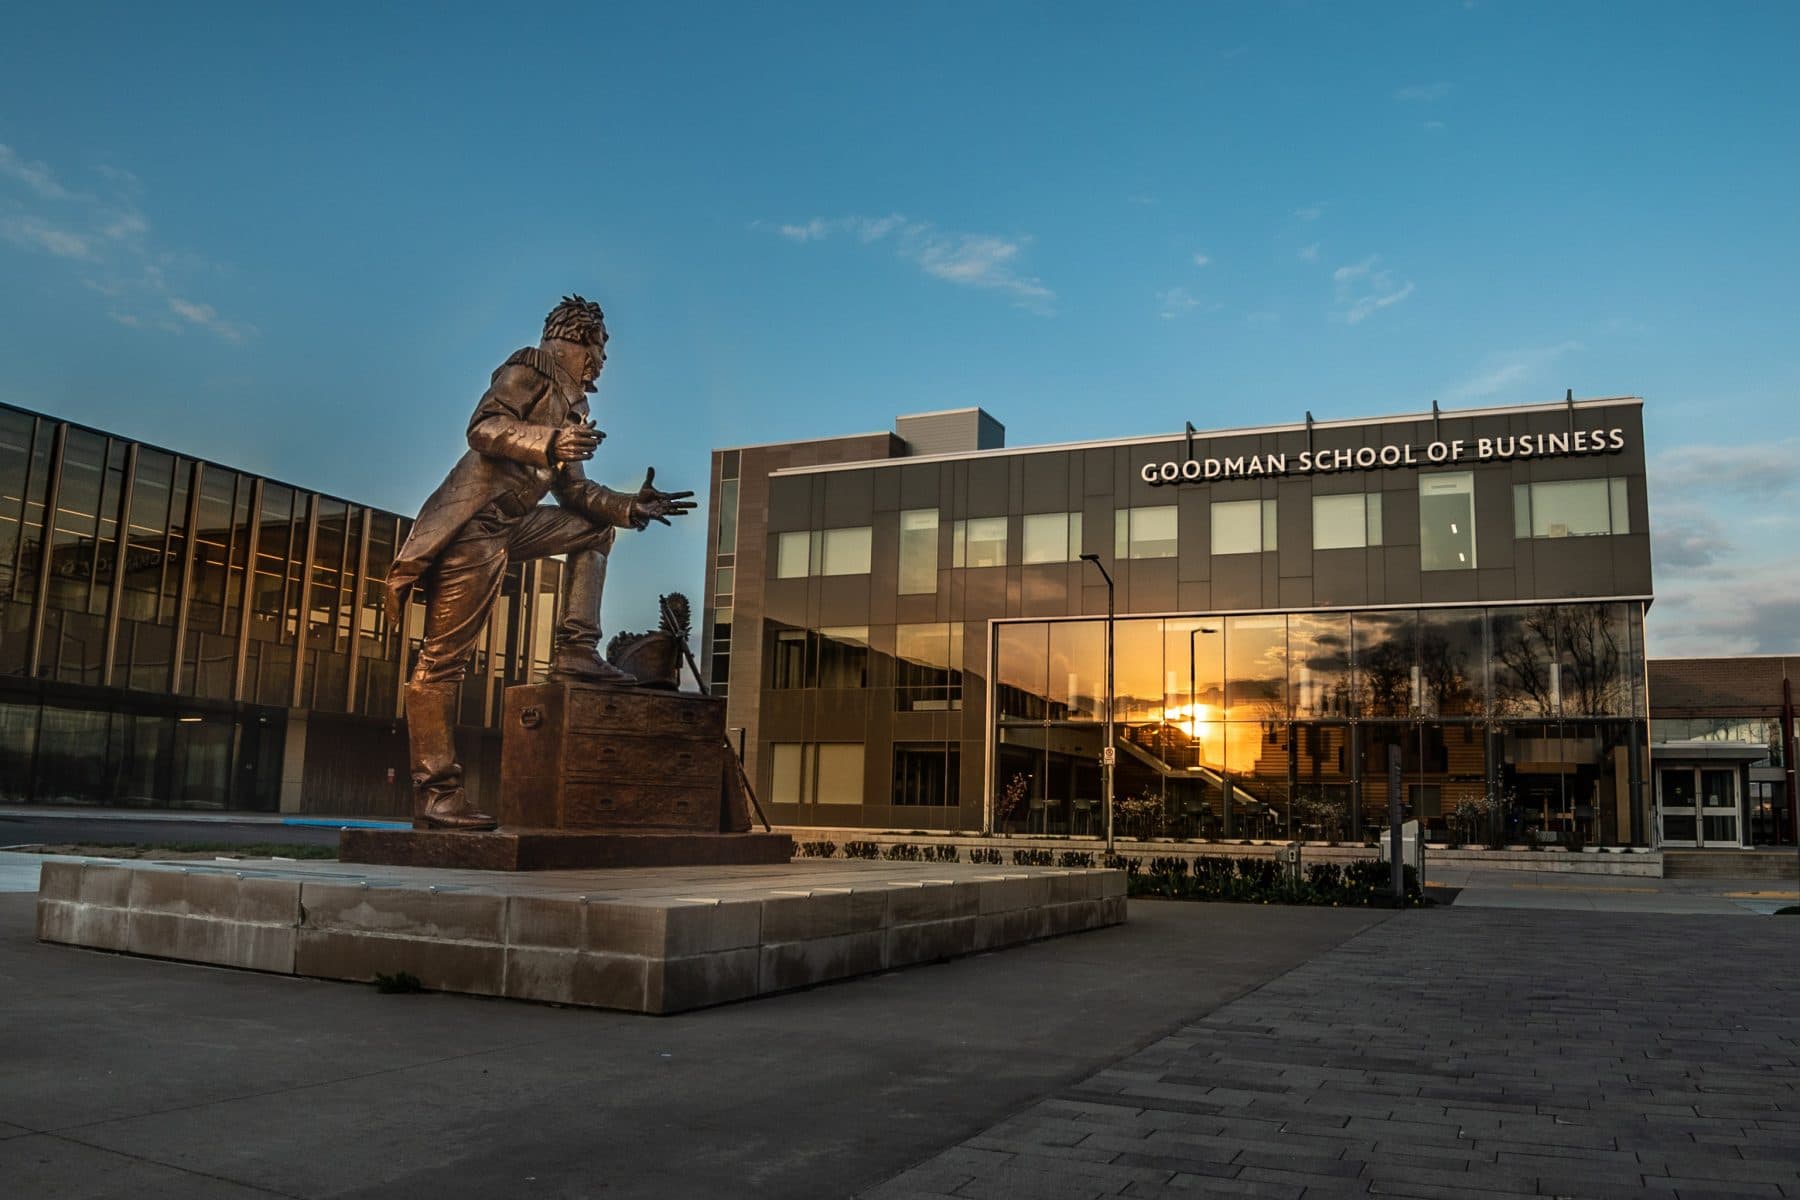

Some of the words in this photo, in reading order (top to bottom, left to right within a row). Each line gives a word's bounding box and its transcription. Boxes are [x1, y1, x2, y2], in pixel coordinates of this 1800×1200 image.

[1141, 453, 1286, 482] GOODMAN
[1299, 444, 1417, 471] SCHOOL
[1427, 440, 1464, 462] OF
[1478, 428, 1625, 458] BUSINESS
